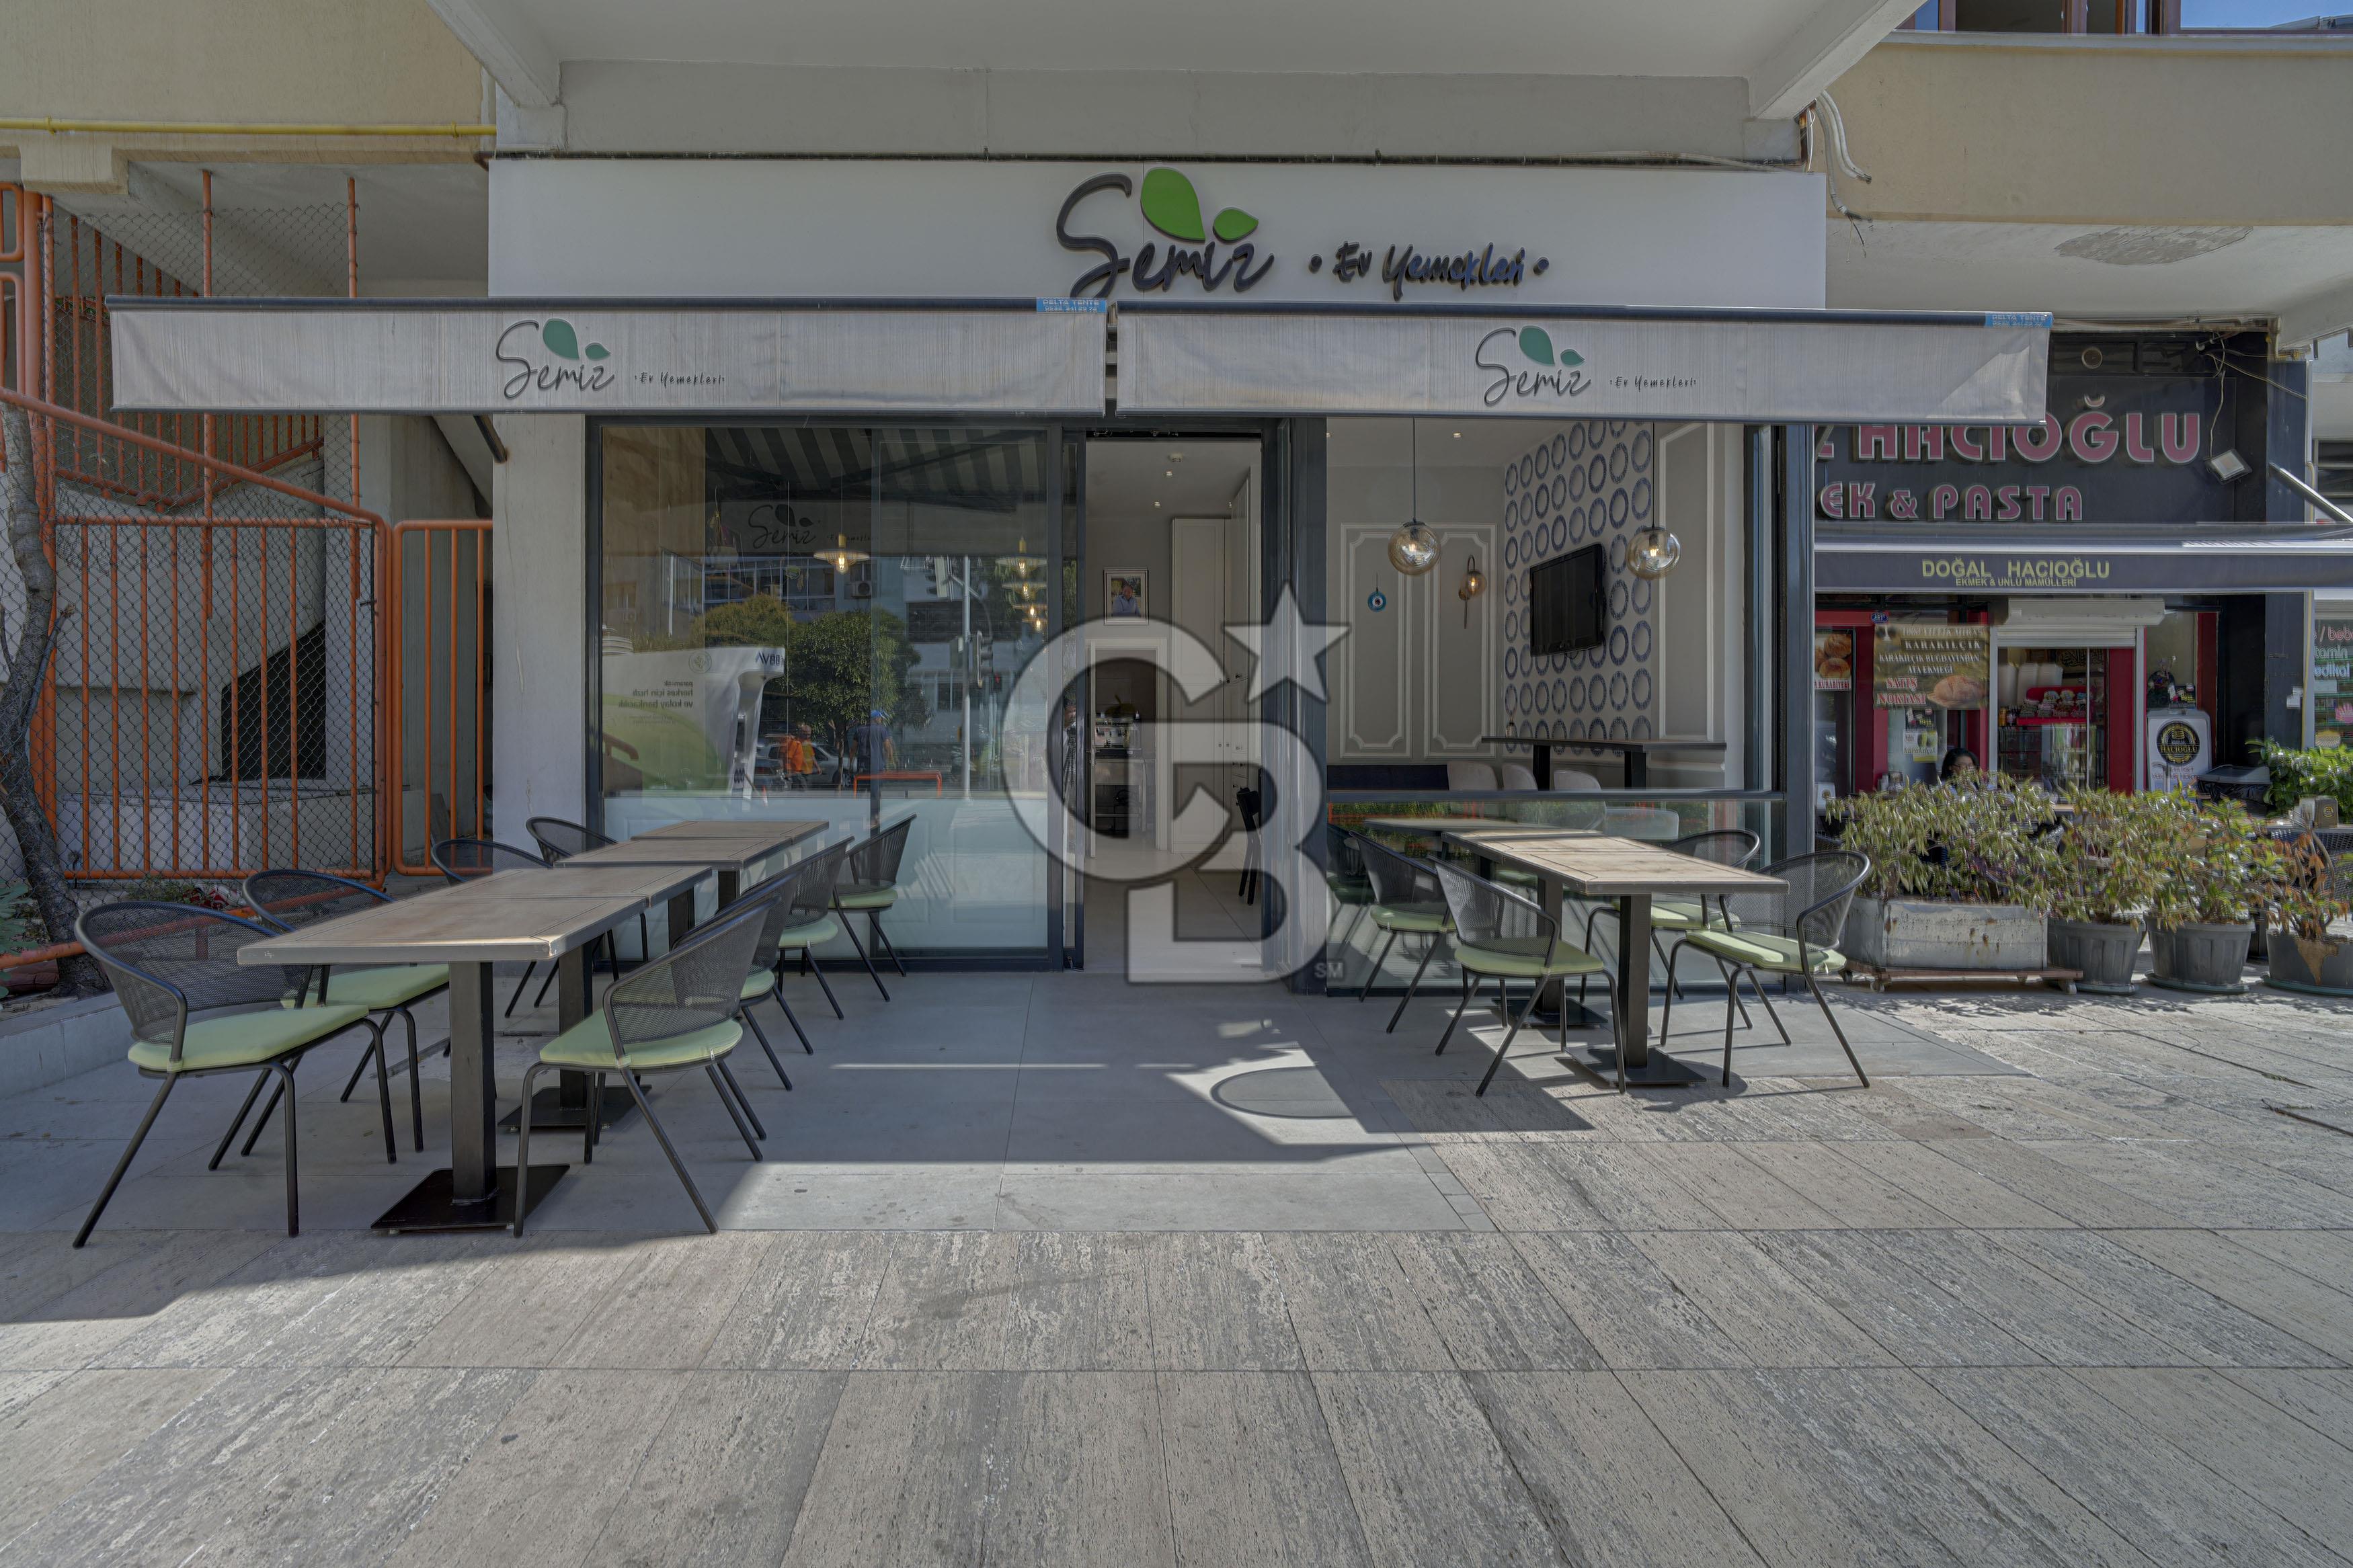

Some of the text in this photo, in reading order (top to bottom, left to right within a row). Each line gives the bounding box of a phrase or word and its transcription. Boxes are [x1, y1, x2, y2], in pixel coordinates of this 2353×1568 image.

[1056, 172, 1275, 298] Semiz
[1334, 241, 1526, 302] Ev Yemekleri
[495, 319, 614, 399] Semiz
[1476, 327, 1591, 407] Semiz
[640, 371, 721, 388] Ev Yemekleri
[1615, 375, 1693, 393] Ev Yemekleri
[1890, 489, 1918, 521] &
[1931, 484, 2082, 522] PASTA
[1921, 557, 2110, 578] DOĞAL HACIOĞLU
[1956, 579, 1988, 587] EKMEK
[1990, 579, 1996, 587] &
[1905, 641, 1981, 651] KARAKILÇIK
